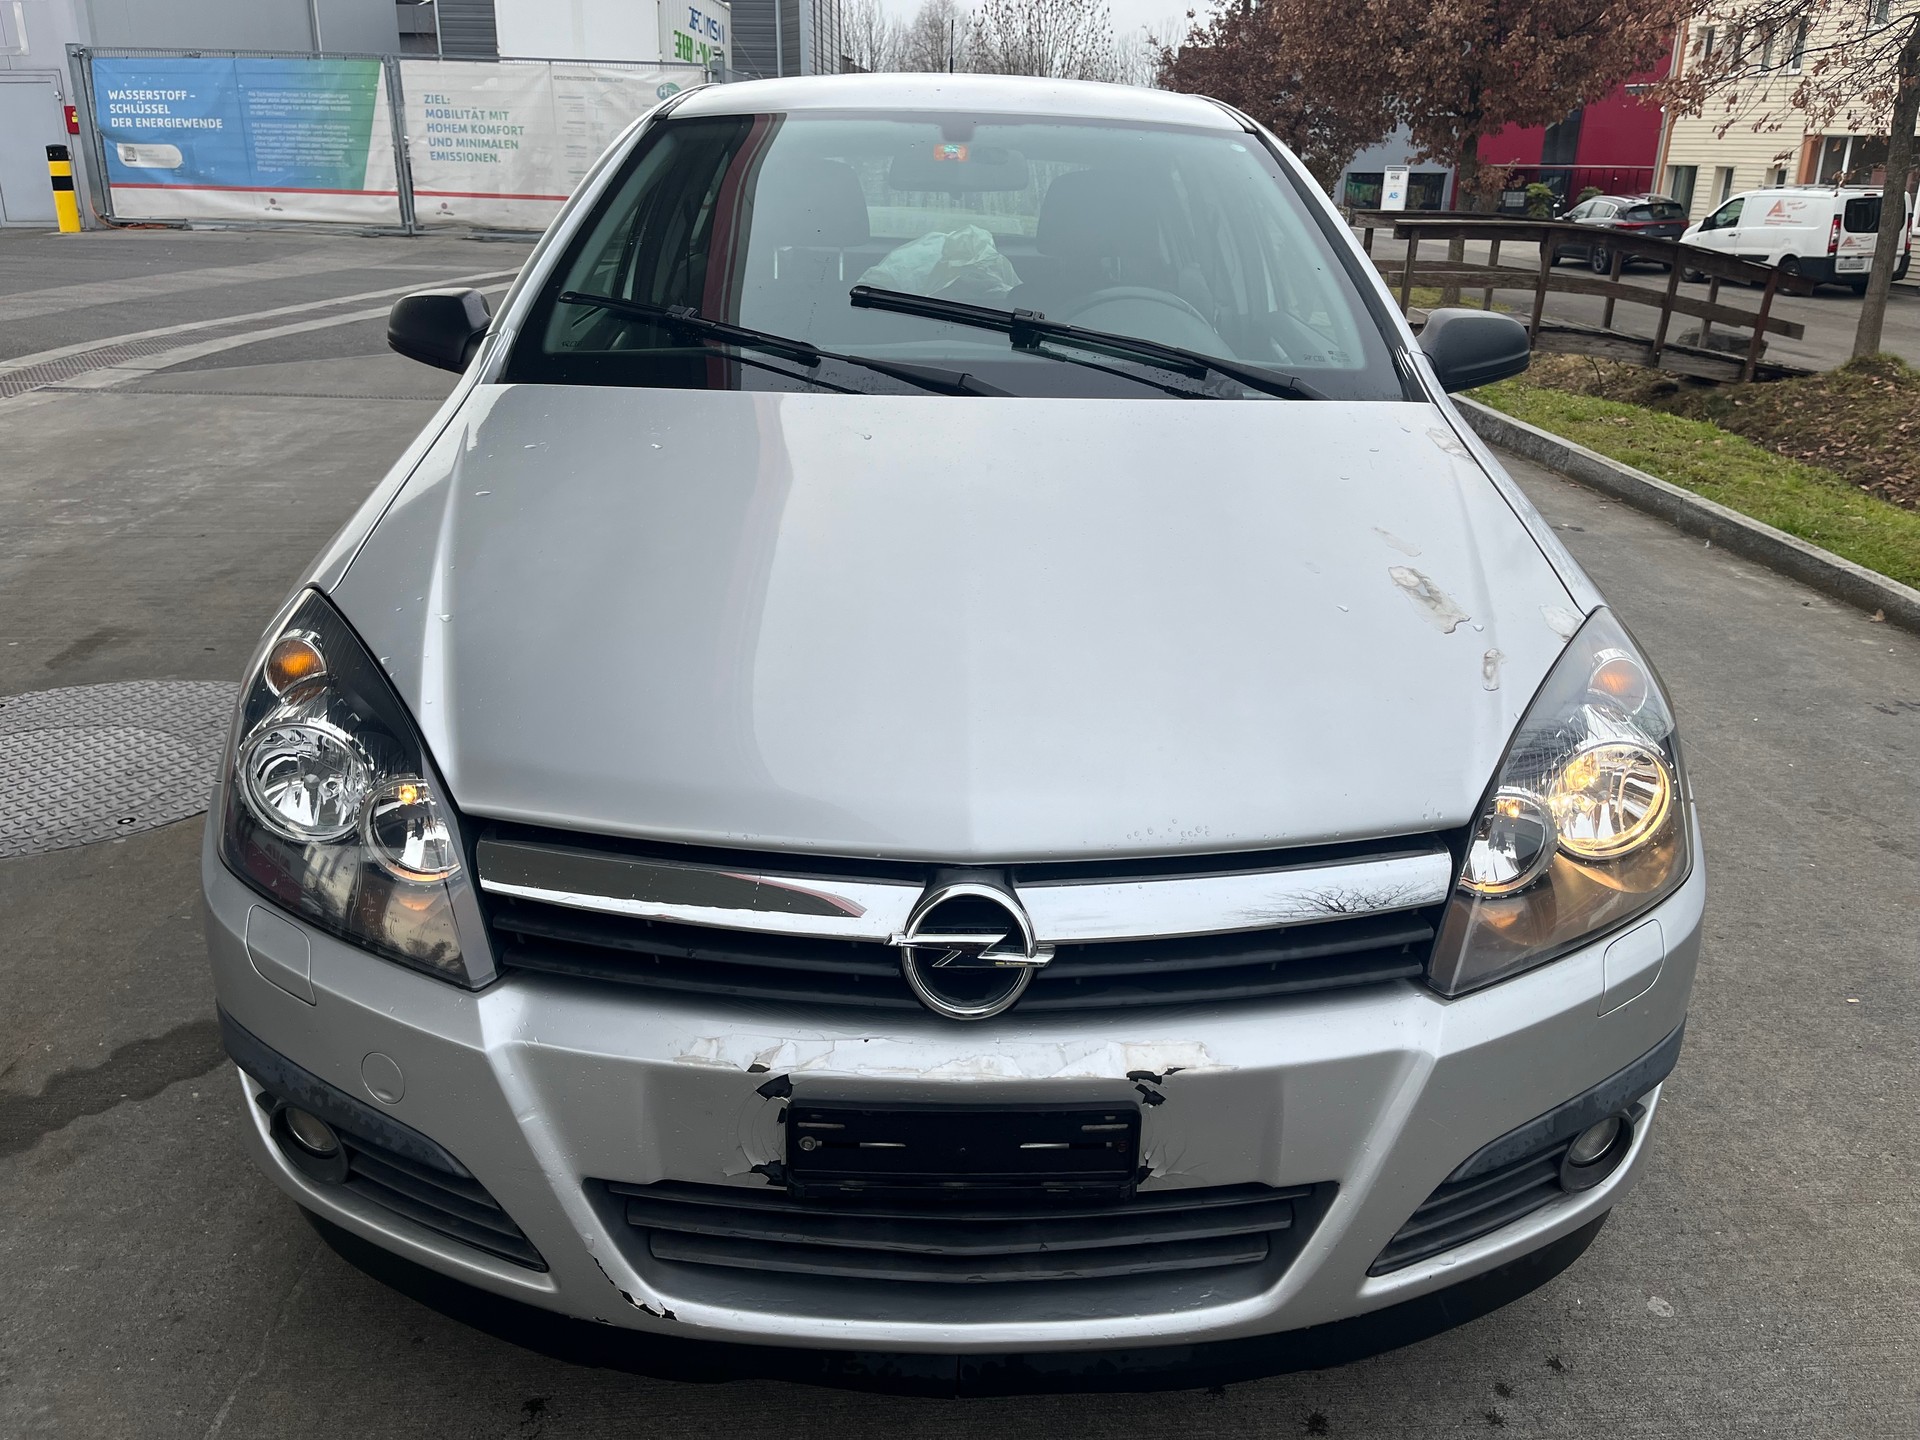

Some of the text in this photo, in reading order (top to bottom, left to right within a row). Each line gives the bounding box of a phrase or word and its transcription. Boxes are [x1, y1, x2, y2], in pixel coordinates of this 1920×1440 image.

[108, 90, 187, 100] WASSERSTOFF
[424, 94, 451, 104] ZIEL:
[109, 101, 171, 114] SCHLÜSSEL
[425, 107, 509, 121] MOBILITÄT MIT
[111, 117, 223, 129] DER ENERGIEWENDE
[427, 123, 524, 136] HOHEM KOMFORT
[428, 137, 519, 149] UND MINIMALEN
[430, 151, 501, 163] EMISSIONEN.
